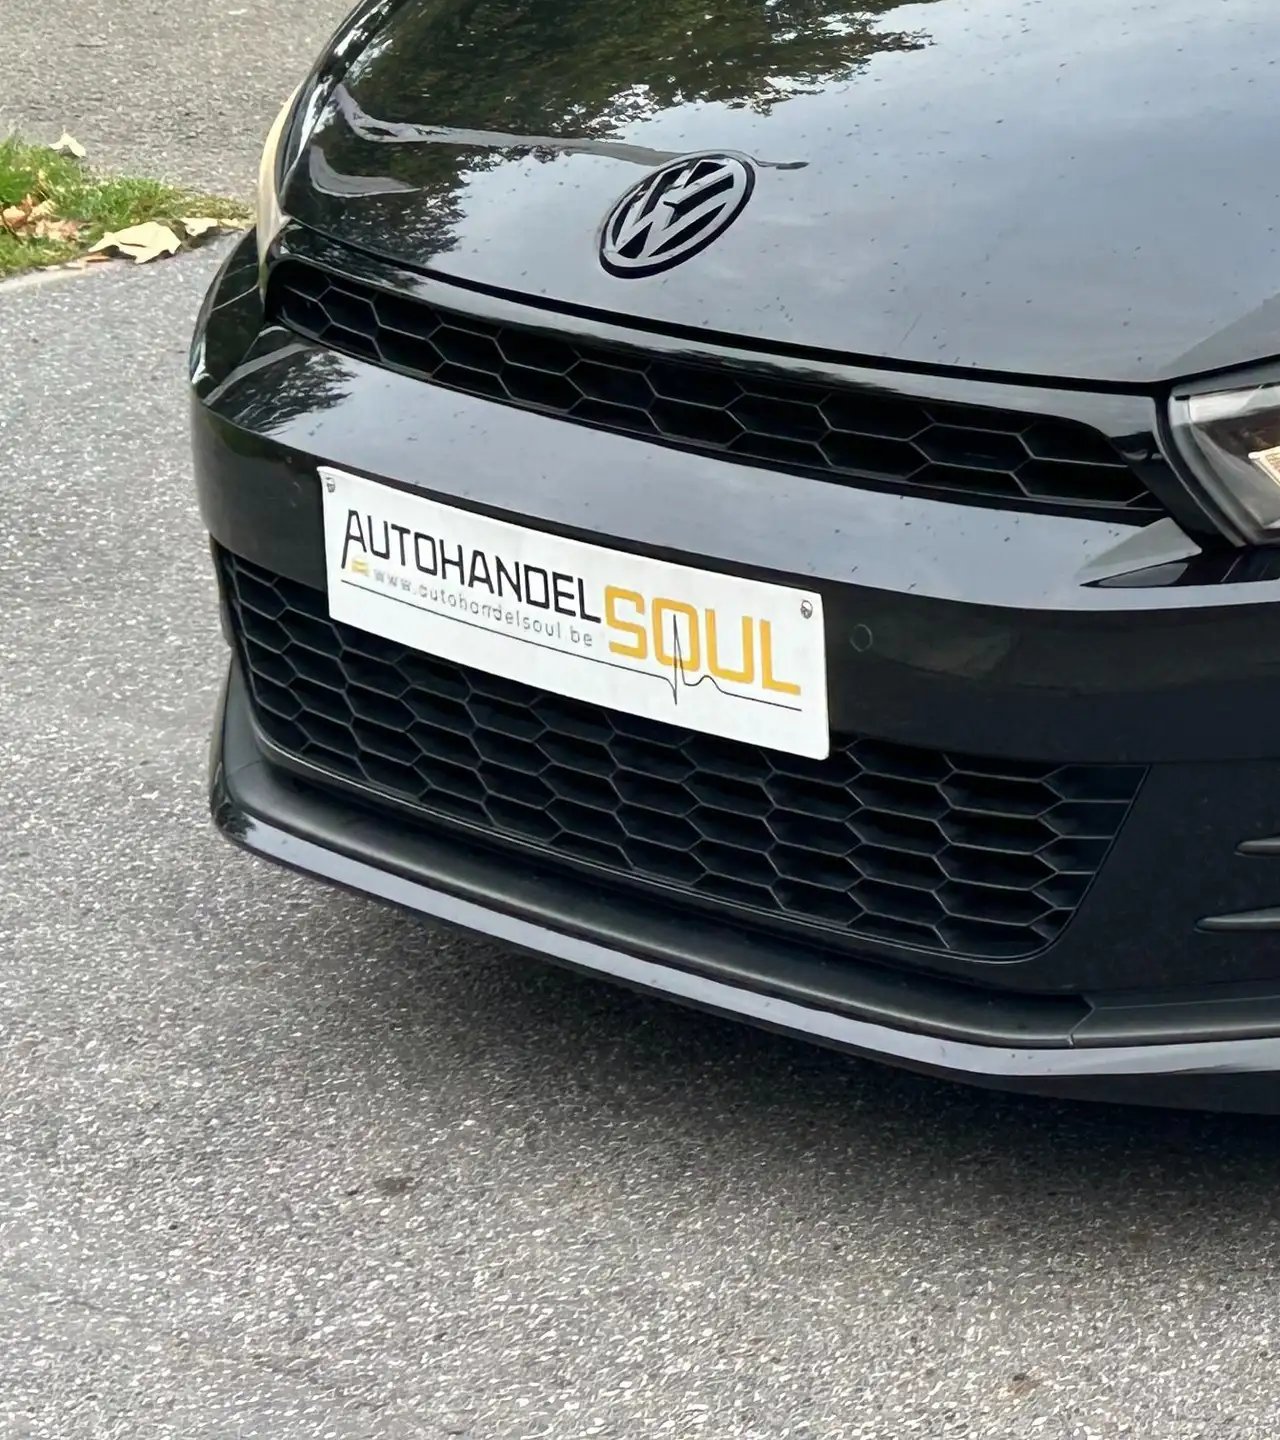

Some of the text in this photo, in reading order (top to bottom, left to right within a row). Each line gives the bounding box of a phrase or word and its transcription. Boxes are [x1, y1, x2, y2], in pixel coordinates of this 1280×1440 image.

[341, 509, 801, 696] AUTOHANDEL SOUL
[373, 568, 594, 647] www.autohandelsoul.be
